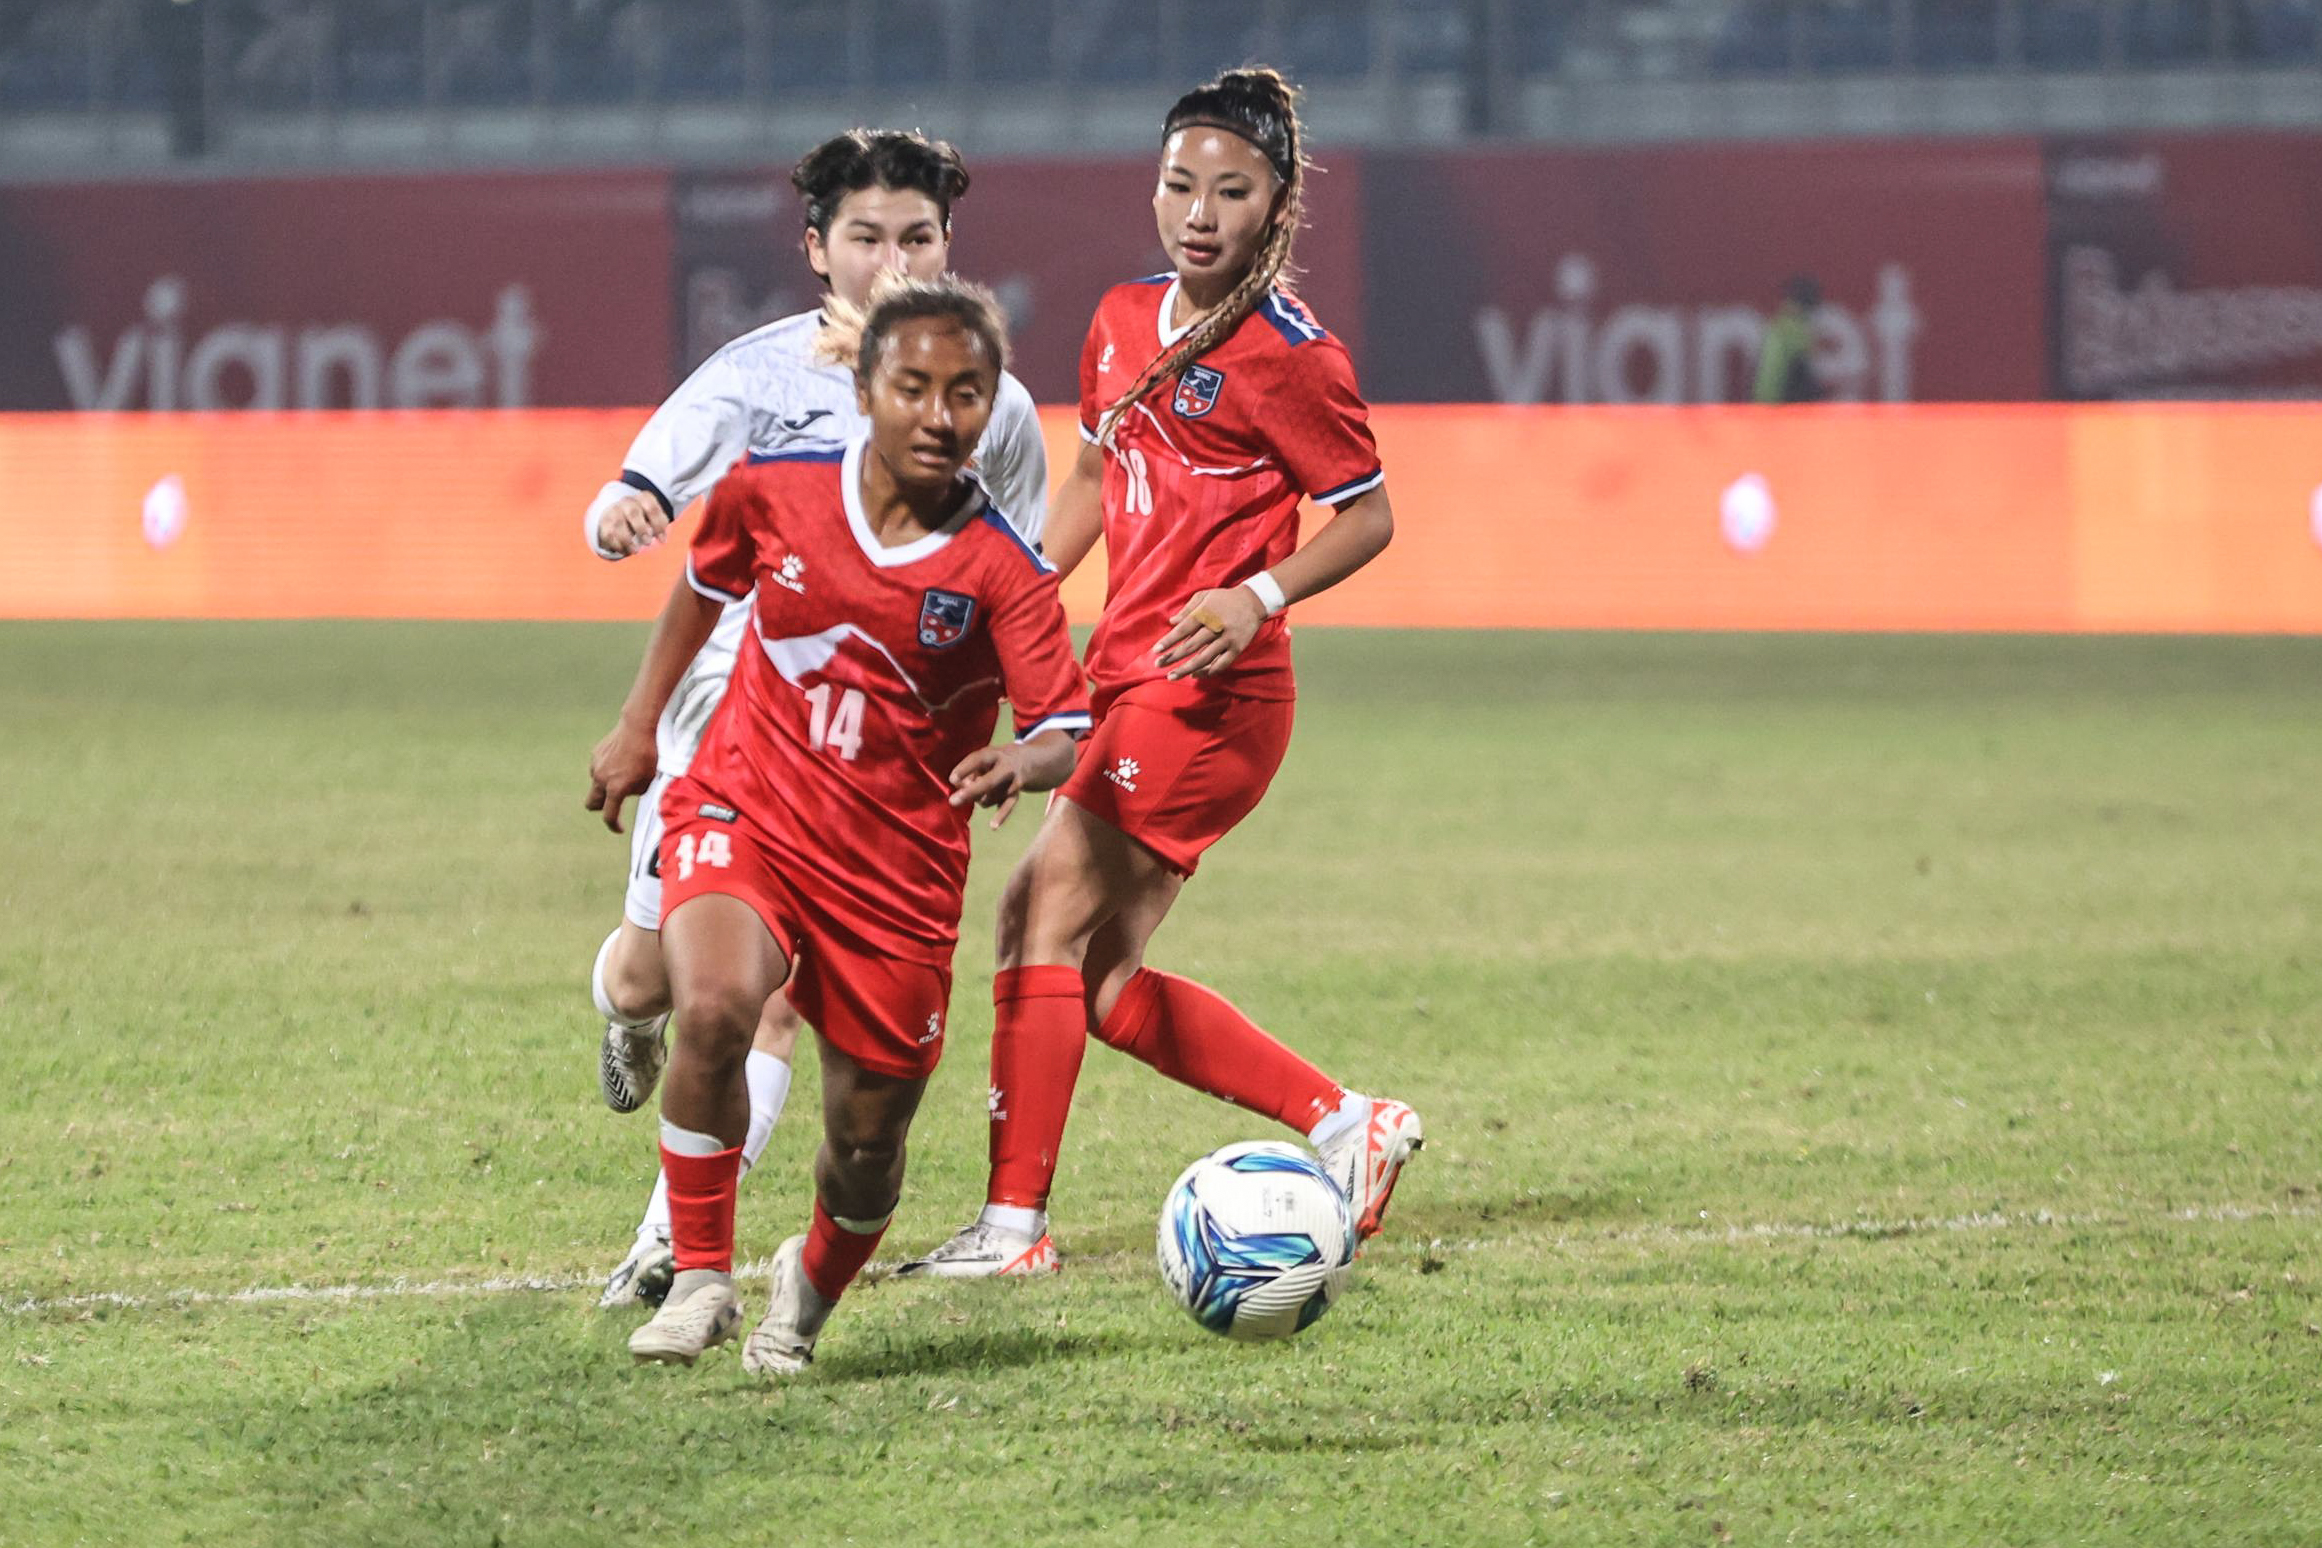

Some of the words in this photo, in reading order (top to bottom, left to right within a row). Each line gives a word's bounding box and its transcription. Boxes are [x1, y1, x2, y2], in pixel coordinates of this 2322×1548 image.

[54, 276, 544, 411] vianet
[804, 682, 867, 760] 14
[675, 830, 733, 881] 14
